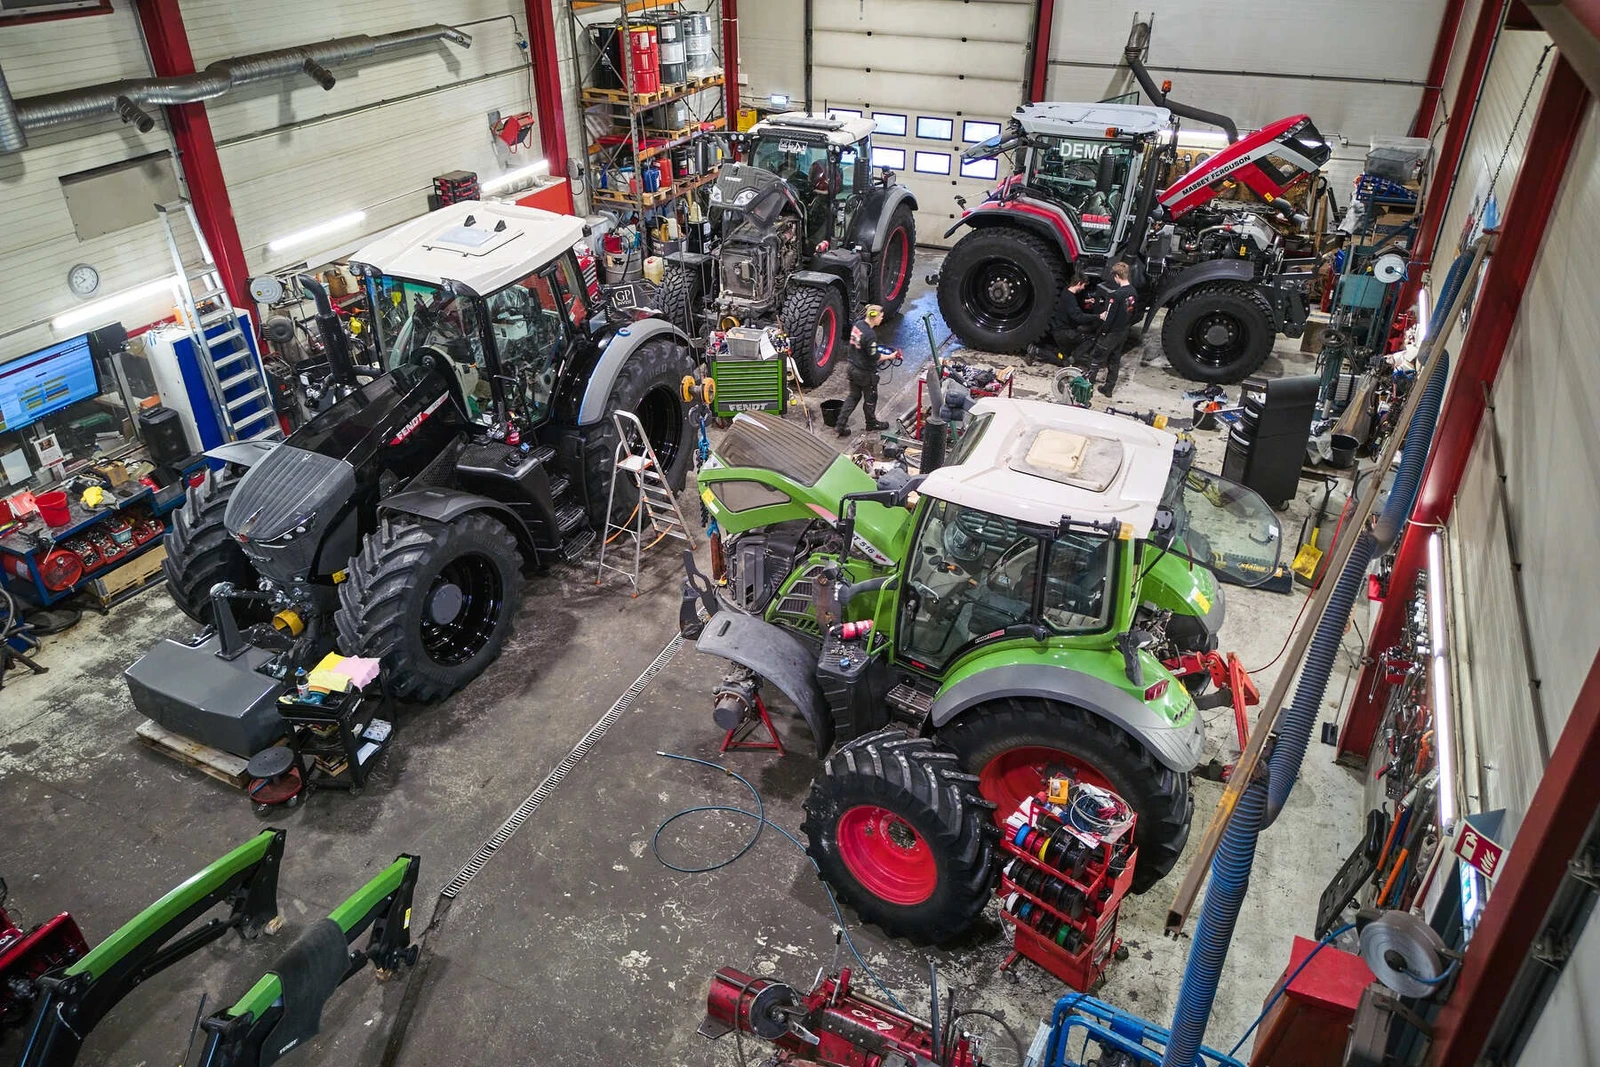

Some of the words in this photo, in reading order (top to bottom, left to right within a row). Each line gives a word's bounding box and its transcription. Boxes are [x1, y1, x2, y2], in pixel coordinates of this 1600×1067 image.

[1182, 177, 1210, 196] MASSEY
[1211, 155, 1251, 180] FERGUSON
[615, 290, 631, 302] GP
[728, 403, 769, 412] FENDT
[396, 411, 423, 441] FENDT
[859, 541, 875, 554] 516
